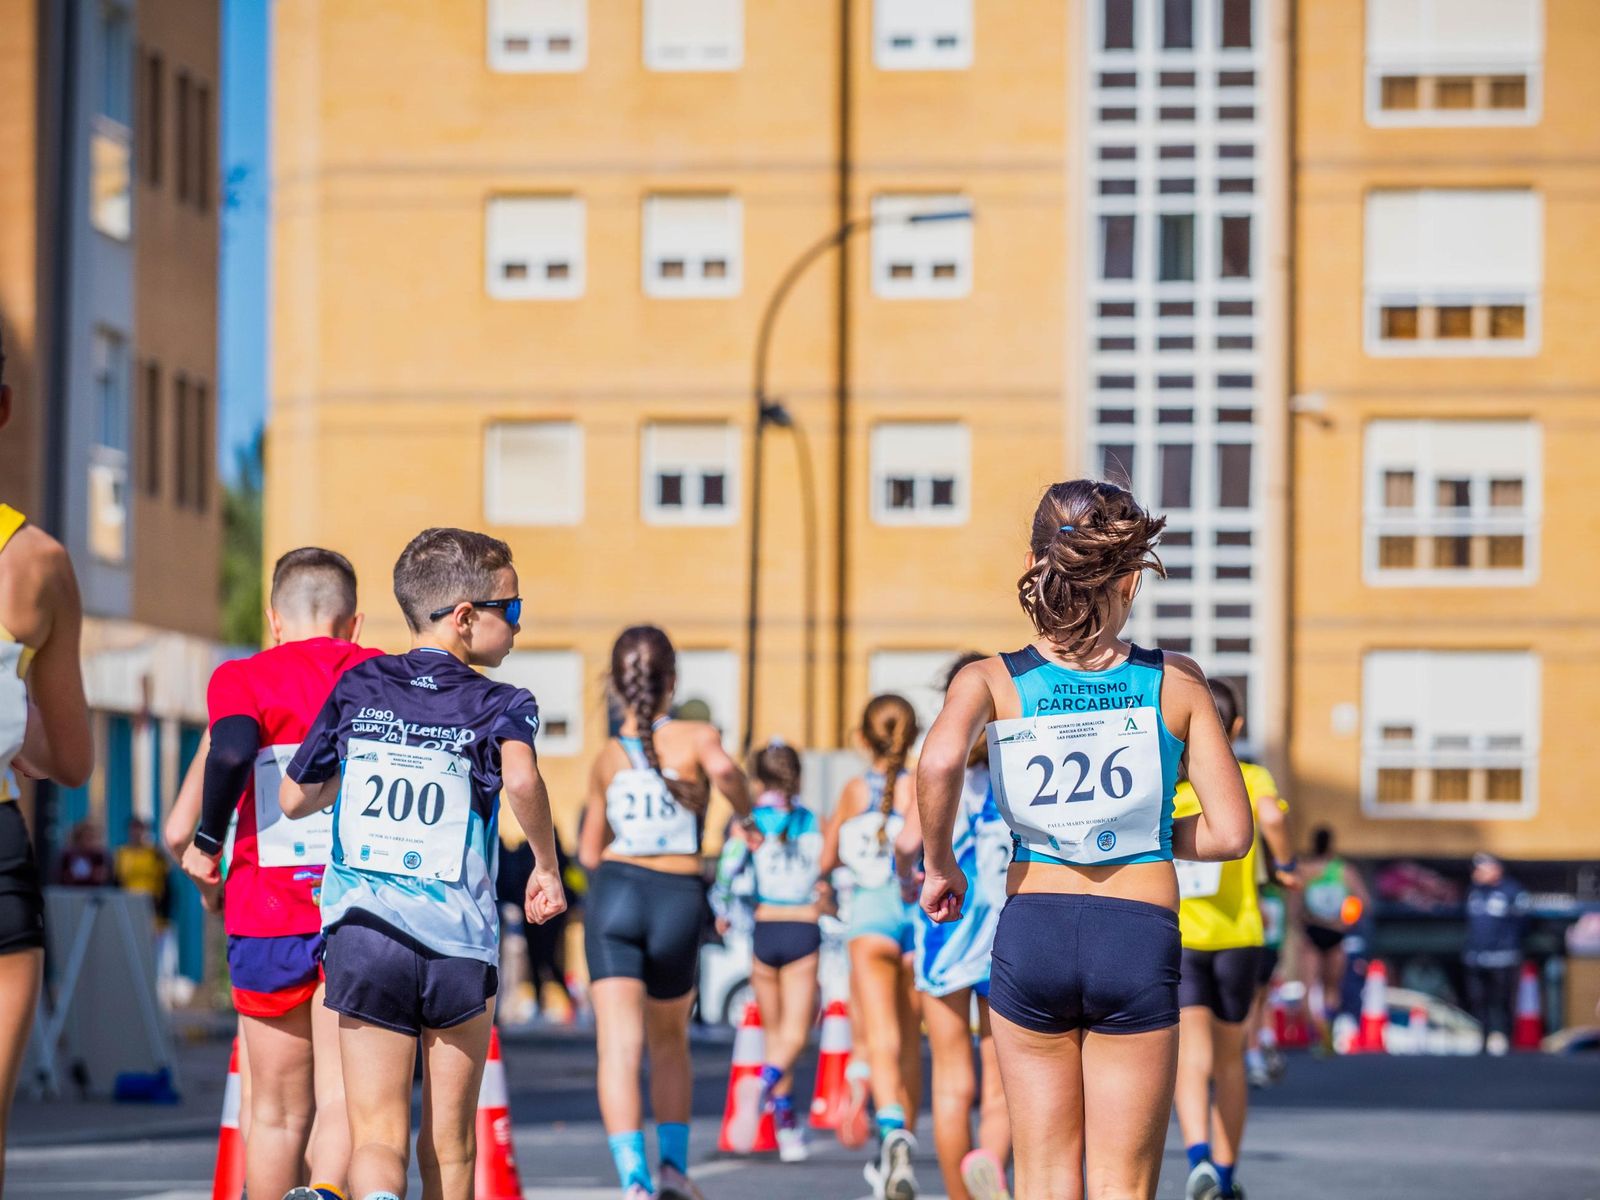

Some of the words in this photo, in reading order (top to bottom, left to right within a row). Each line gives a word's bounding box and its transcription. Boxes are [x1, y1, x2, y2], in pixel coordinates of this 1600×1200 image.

[1037, 694, 1144, 711] CARCABUEY
[1052, 682, 1128, 695] ATLETISMO
[1025, 745, 1133, 806] 226
[360, 774, 445, 826] 200
[623, 792, 677, 820] 218
